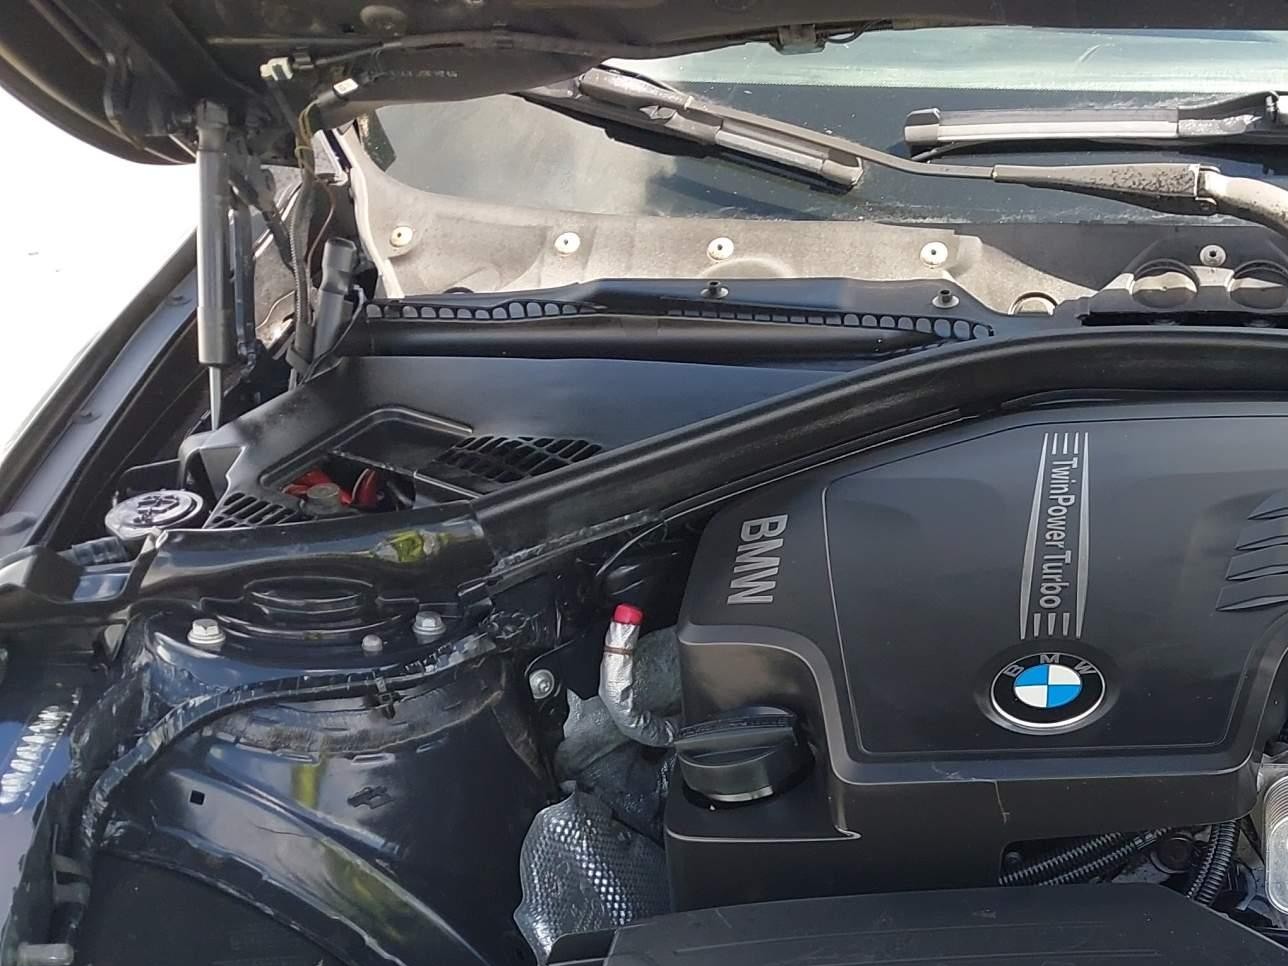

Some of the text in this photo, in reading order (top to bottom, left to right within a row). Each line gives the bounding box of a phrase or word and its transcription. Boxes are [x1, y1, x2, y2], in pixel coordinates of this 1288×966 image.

[727, 514, 788, 605] BMW
[1039, 457, 1078, 609] TwinPower Turbo
[1002, 653, 1097, 677] BMW
